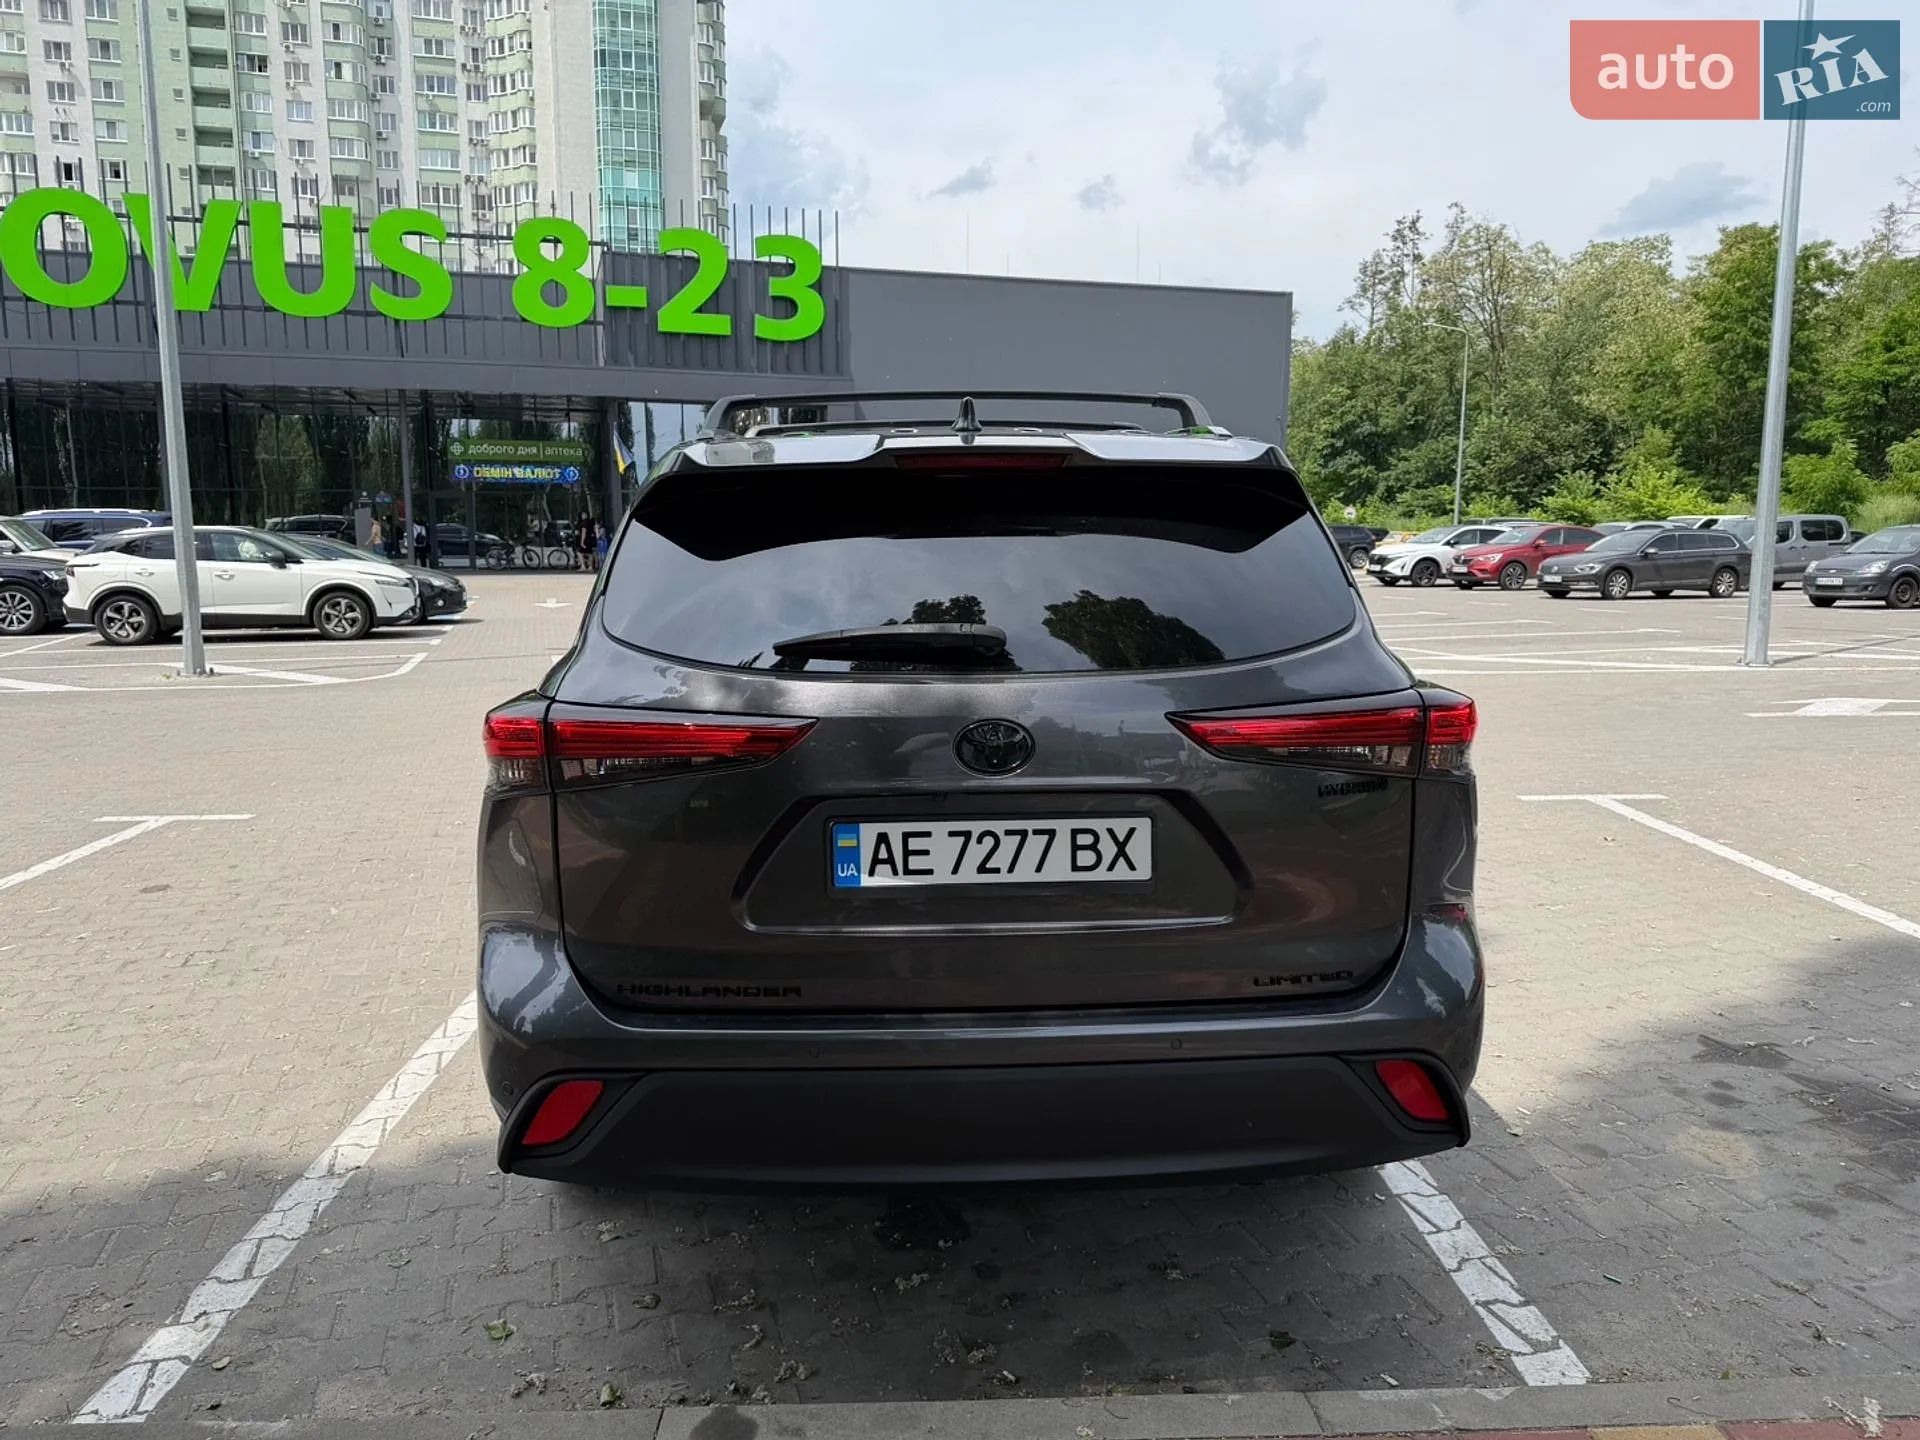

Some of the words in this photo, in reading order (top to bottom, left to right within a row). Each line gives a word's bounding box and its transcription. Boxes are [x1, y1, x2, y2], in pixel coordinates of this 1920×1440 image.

[512, 217, 825, 342] 8-23
[468, 443, 515, 456] доброго
[517, 445, 537, 456] дня
[544, 446, 583, 457] аптека
[867, 831, 934, 877] AE
[947, 828, 1057, 875] 7277
[1070, 826, 1138, 873] BX
[838, 863, 858, 877] UA
[617, 983, 801, 998] HIGHLANDER
